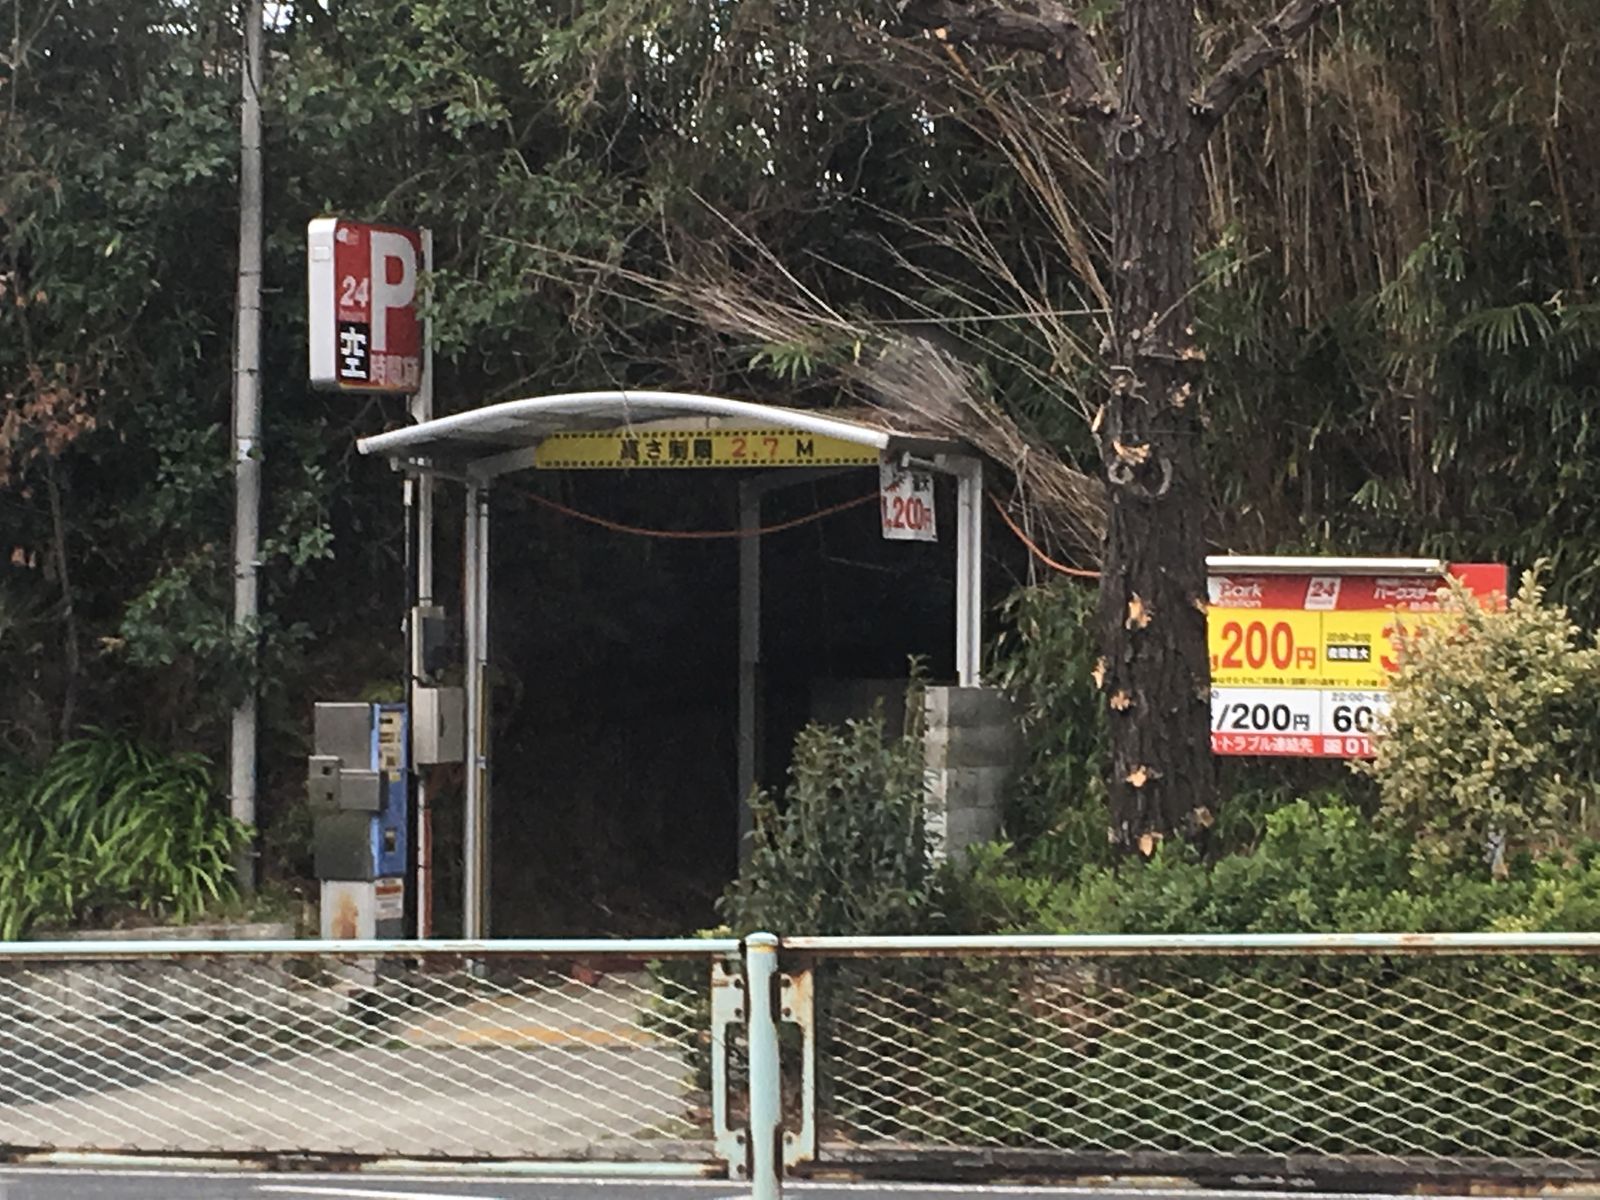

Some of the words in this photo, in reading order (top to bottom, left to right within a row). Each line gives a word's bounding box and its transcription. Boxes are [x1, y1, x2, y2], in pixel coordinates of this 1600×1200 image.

[340, 275, 369, 307] 24
[370, 231, 417, 351] P
[340, 326, 368, 379] 空
[731, 437, 779, 458] 2.7
[796, 440, 815, 458] M
[1219, 582, 1264, 598] Park
[1310, 581, 1336, 597] 24
[1211, 703, 1310, 731] /200円
